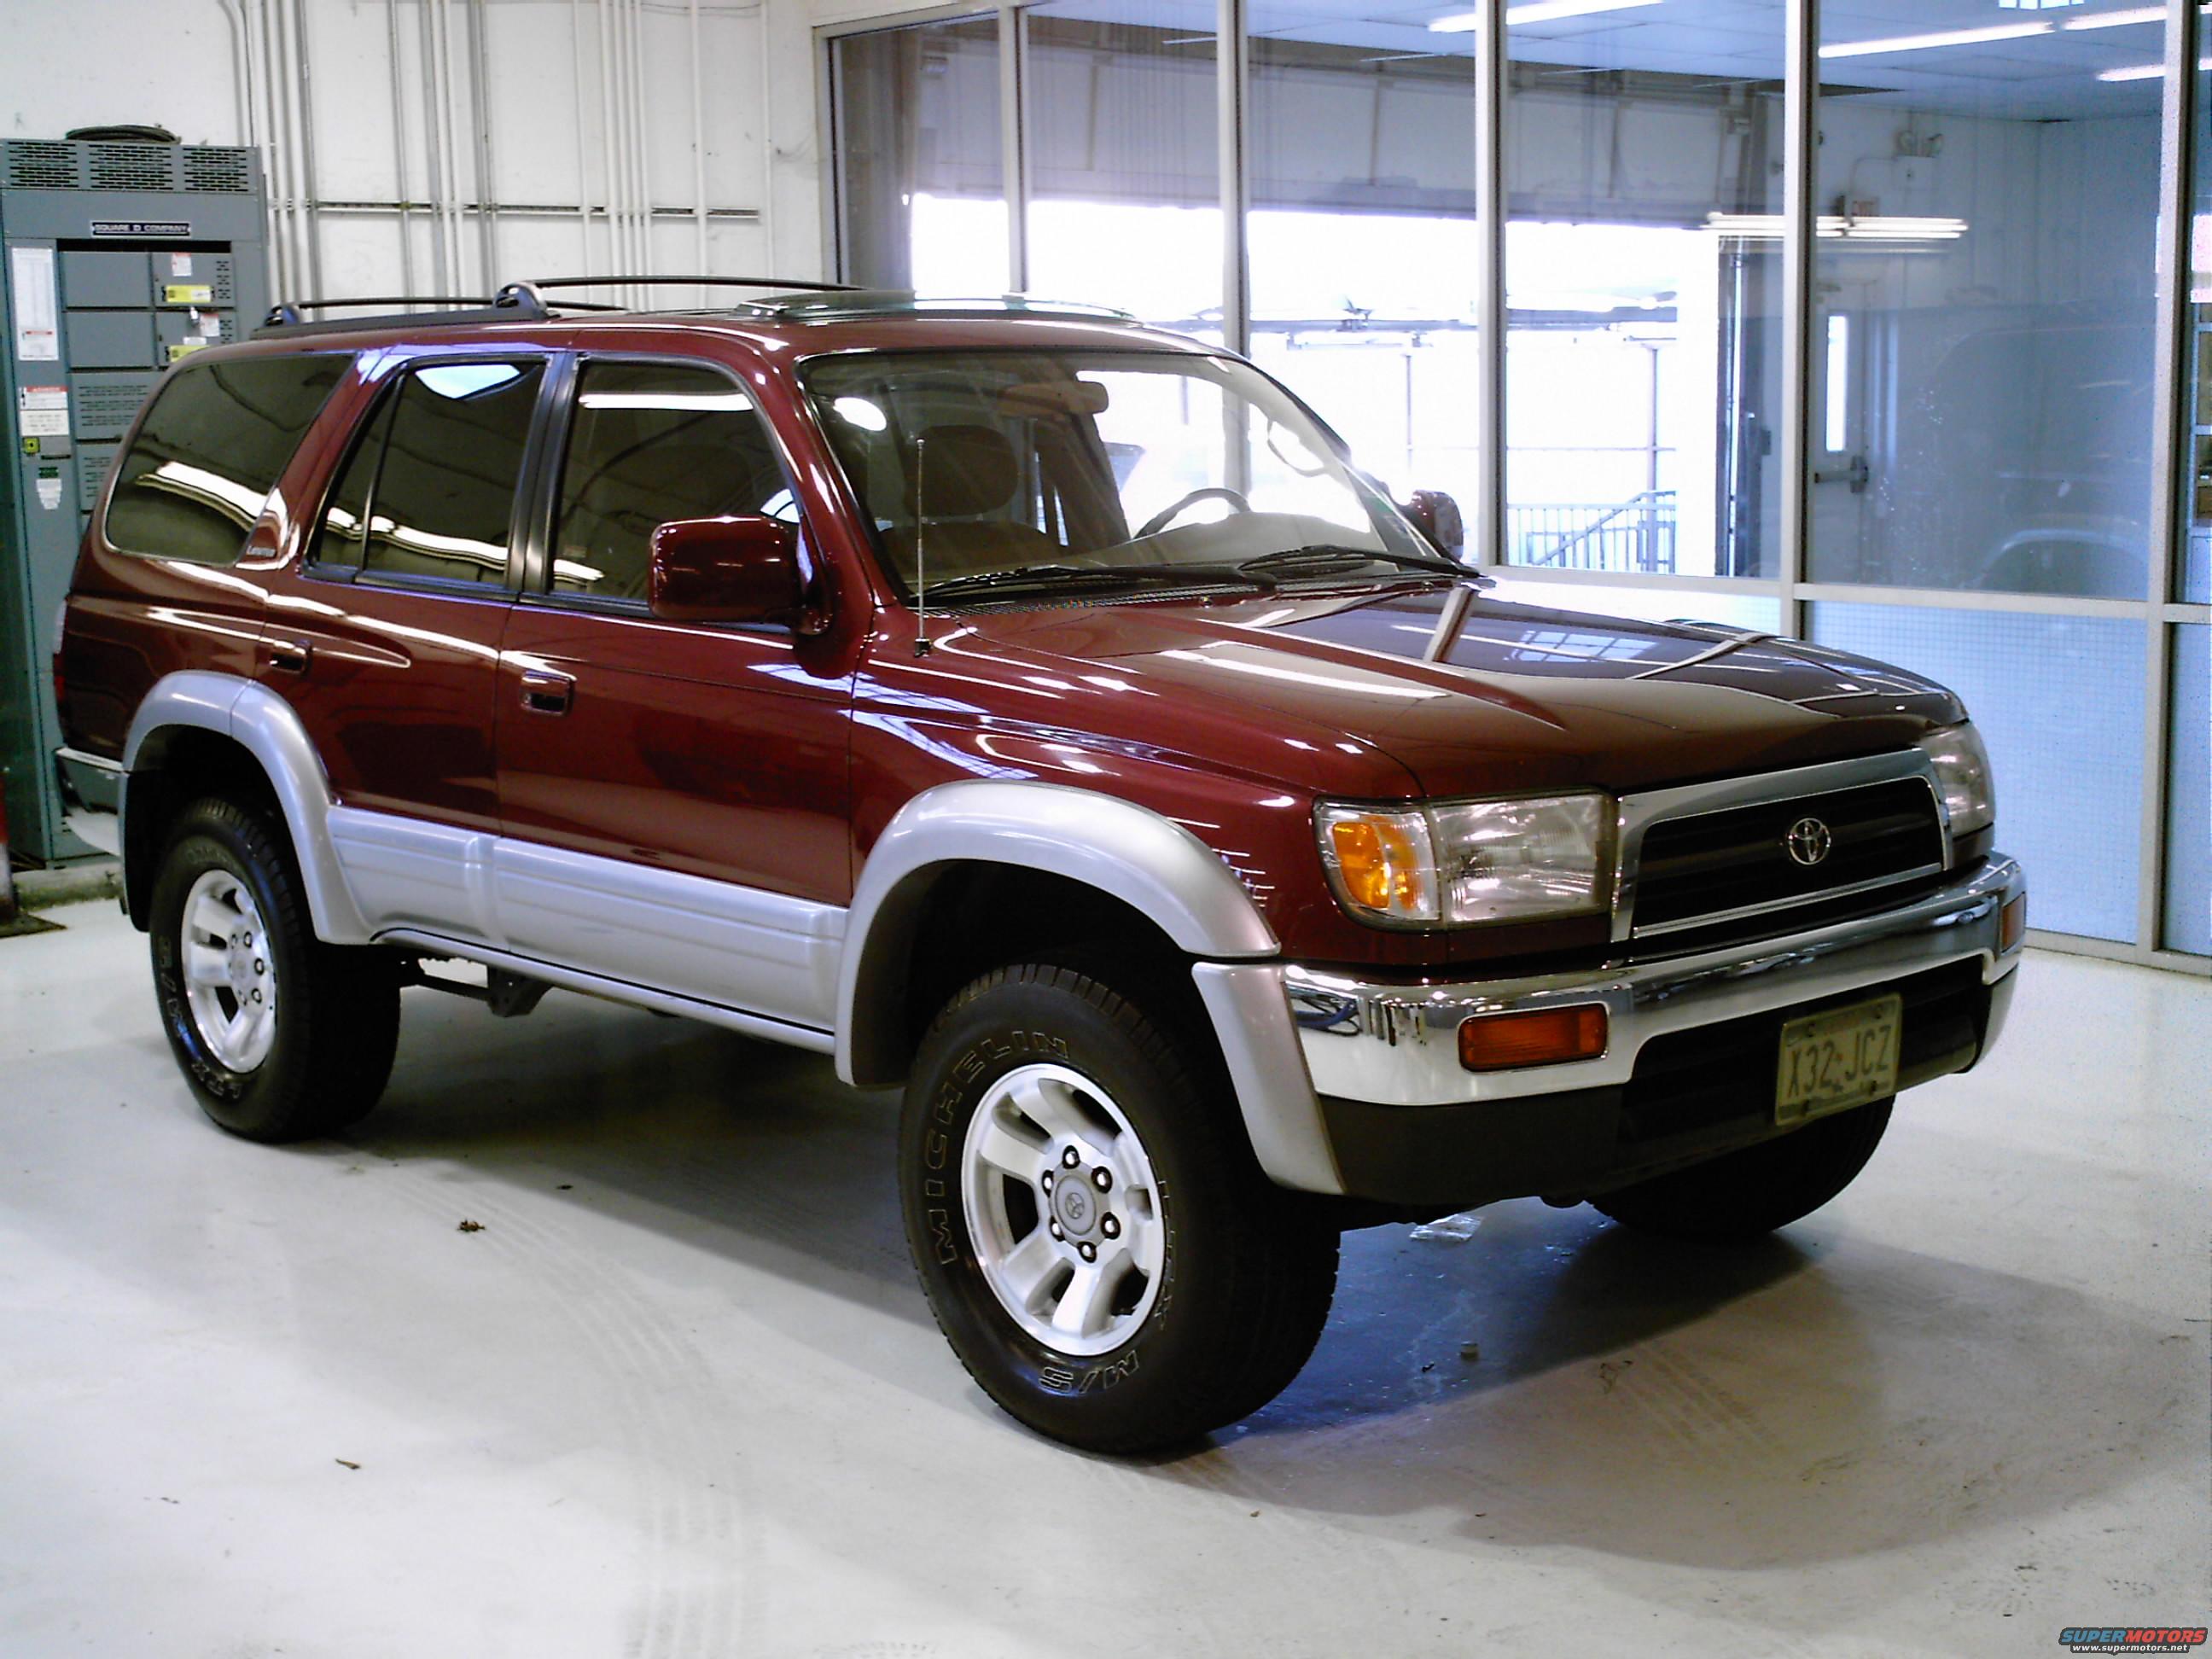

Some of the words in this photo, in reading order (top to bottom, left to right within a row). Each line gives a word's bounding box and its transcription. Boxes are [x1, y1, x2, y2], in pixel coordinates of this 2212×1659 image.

[94, 224, 130, 232] SQUARE
[143, 224, 187, 233] COMPANY
[925, 1030, 1070, 1266] MICHELIN
